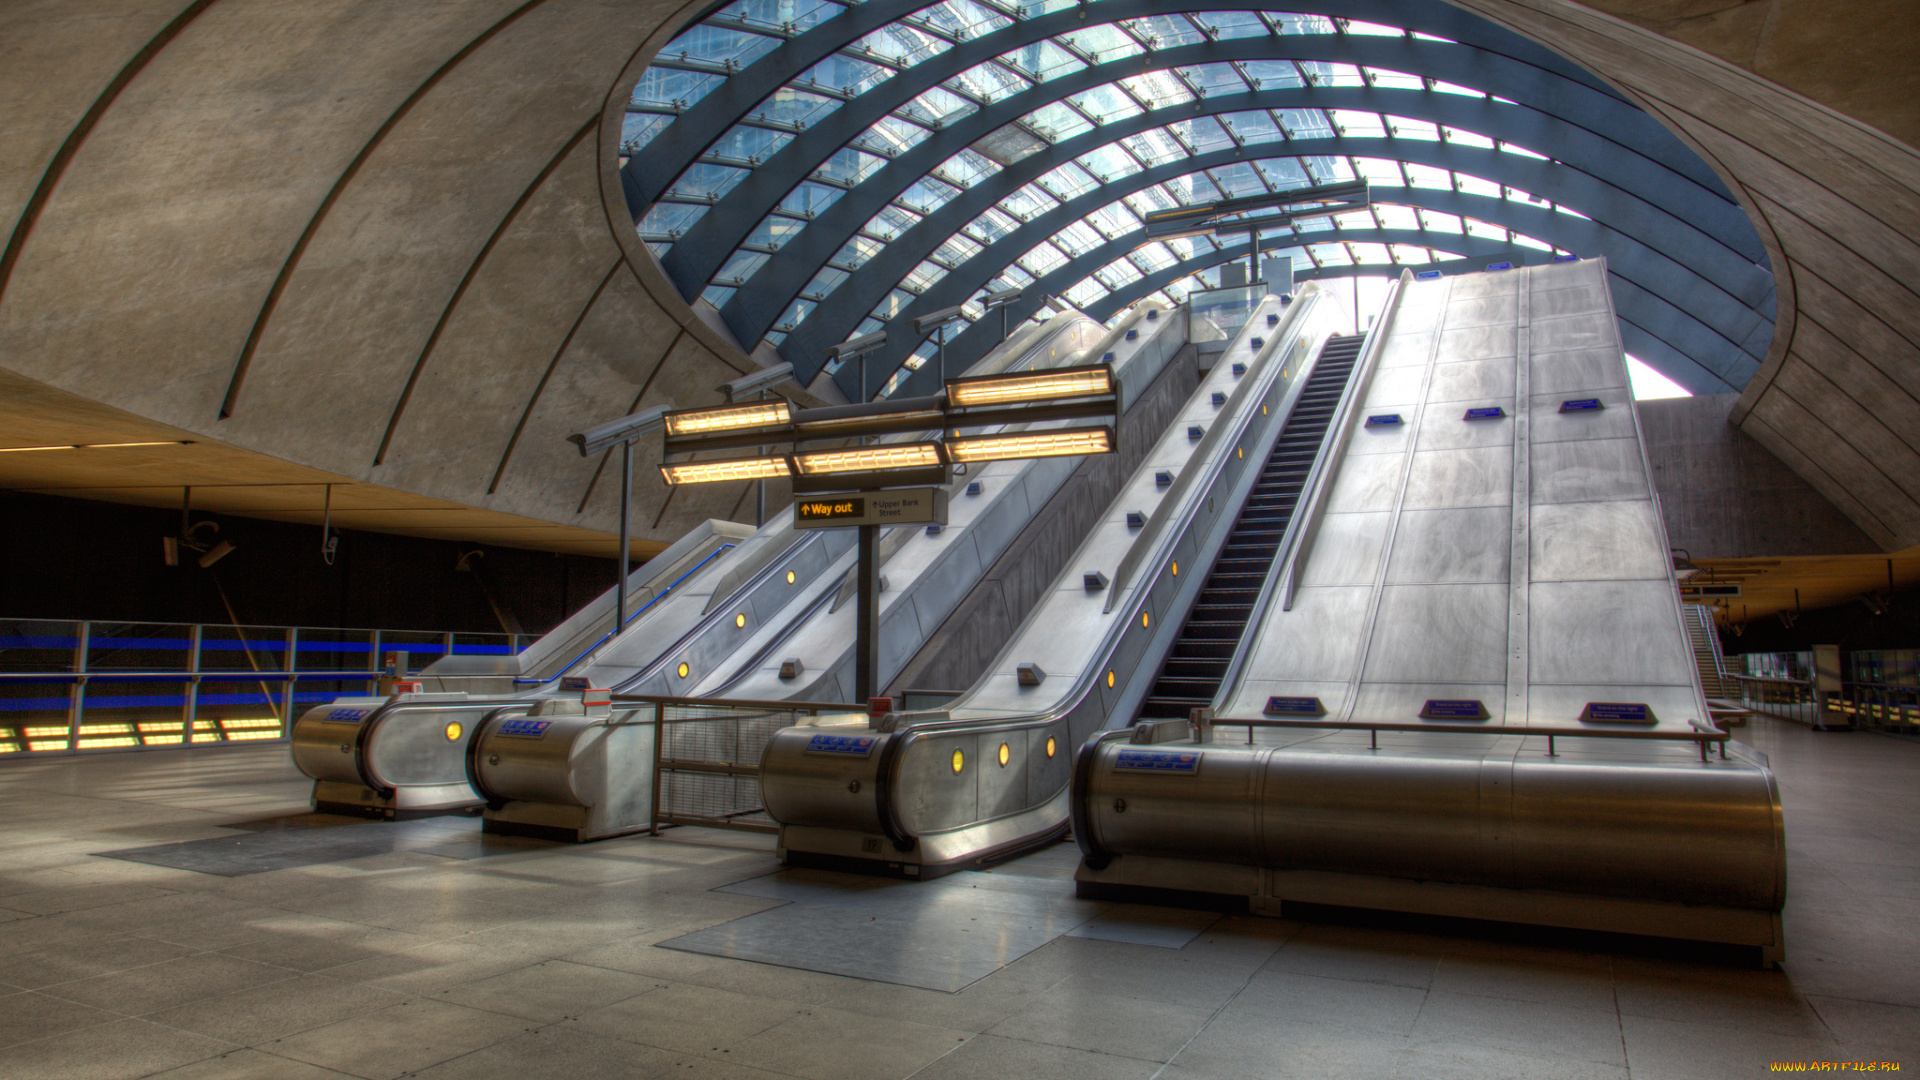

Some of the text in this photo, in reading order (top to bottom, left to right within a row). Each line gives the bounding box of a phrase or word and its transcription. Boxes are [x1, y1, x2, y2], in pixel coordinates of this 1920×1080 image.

[811, 502, 853, 516] Way out
[878, 498, 919, 509] Upper Bank
[878, 509, 901, 517] Street
[868, 839, 877, 852] 19
